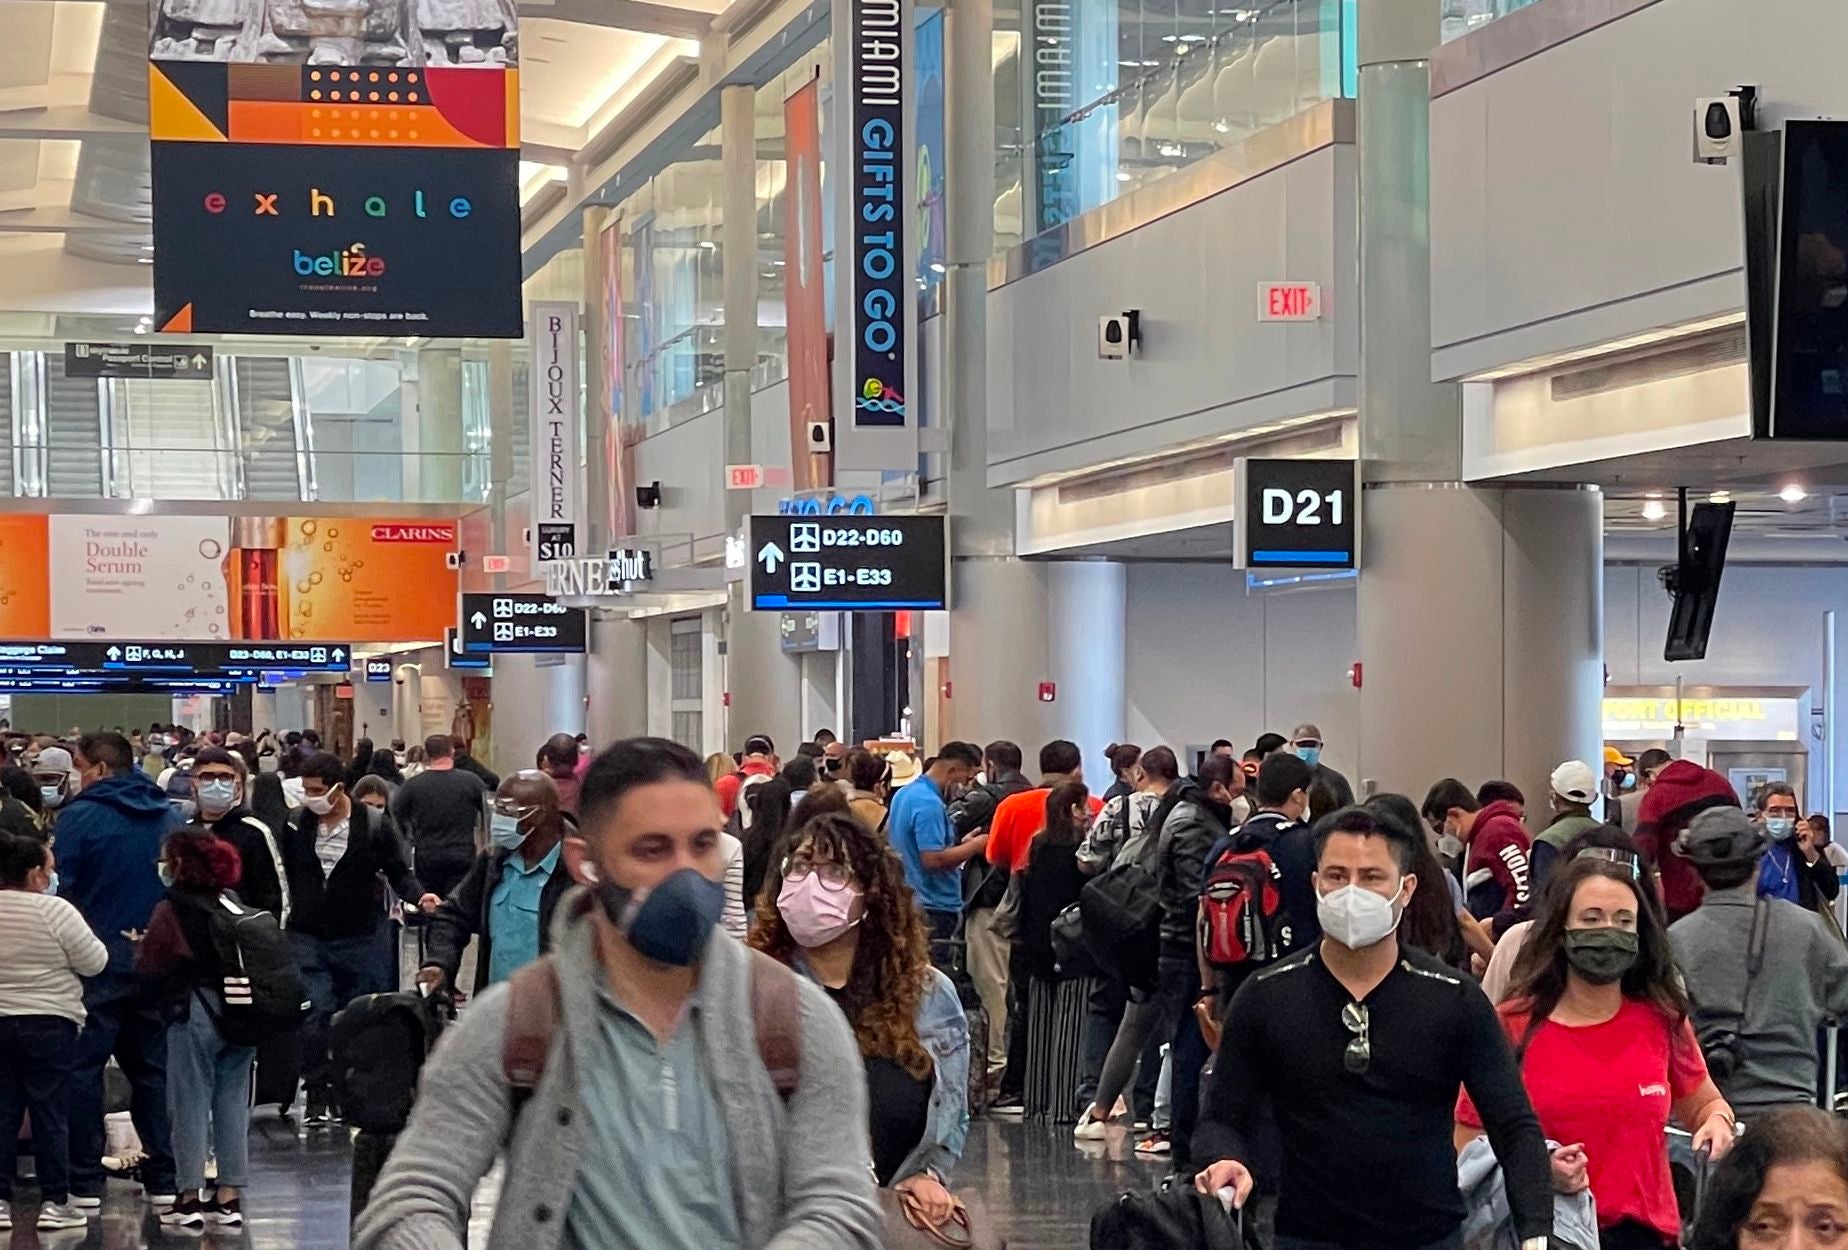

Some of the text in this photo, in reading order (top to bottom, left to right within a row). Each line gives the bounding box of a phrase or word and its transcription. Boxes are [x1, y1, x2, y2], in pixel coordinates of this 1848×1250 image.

[861, 0, 900, 354] MIAMI GIFTS TO GO
[293, 247, 386, 277] belize
[1269, 287, 1307, 316] EXIT
[548, 316, 564, 519] BIJOUX TERNER
[732, 467, 757, 486] EXIT
[1262, 488, 1343, 526] D21
[371, 526, 454, 541] CLARINS
[86, 541, 149, 558] Double
[86, 557, 142, 574] Serum
[823, 568, 893, 586] E1-E33
[1499, 843, 1530, 909] HOLLIS
